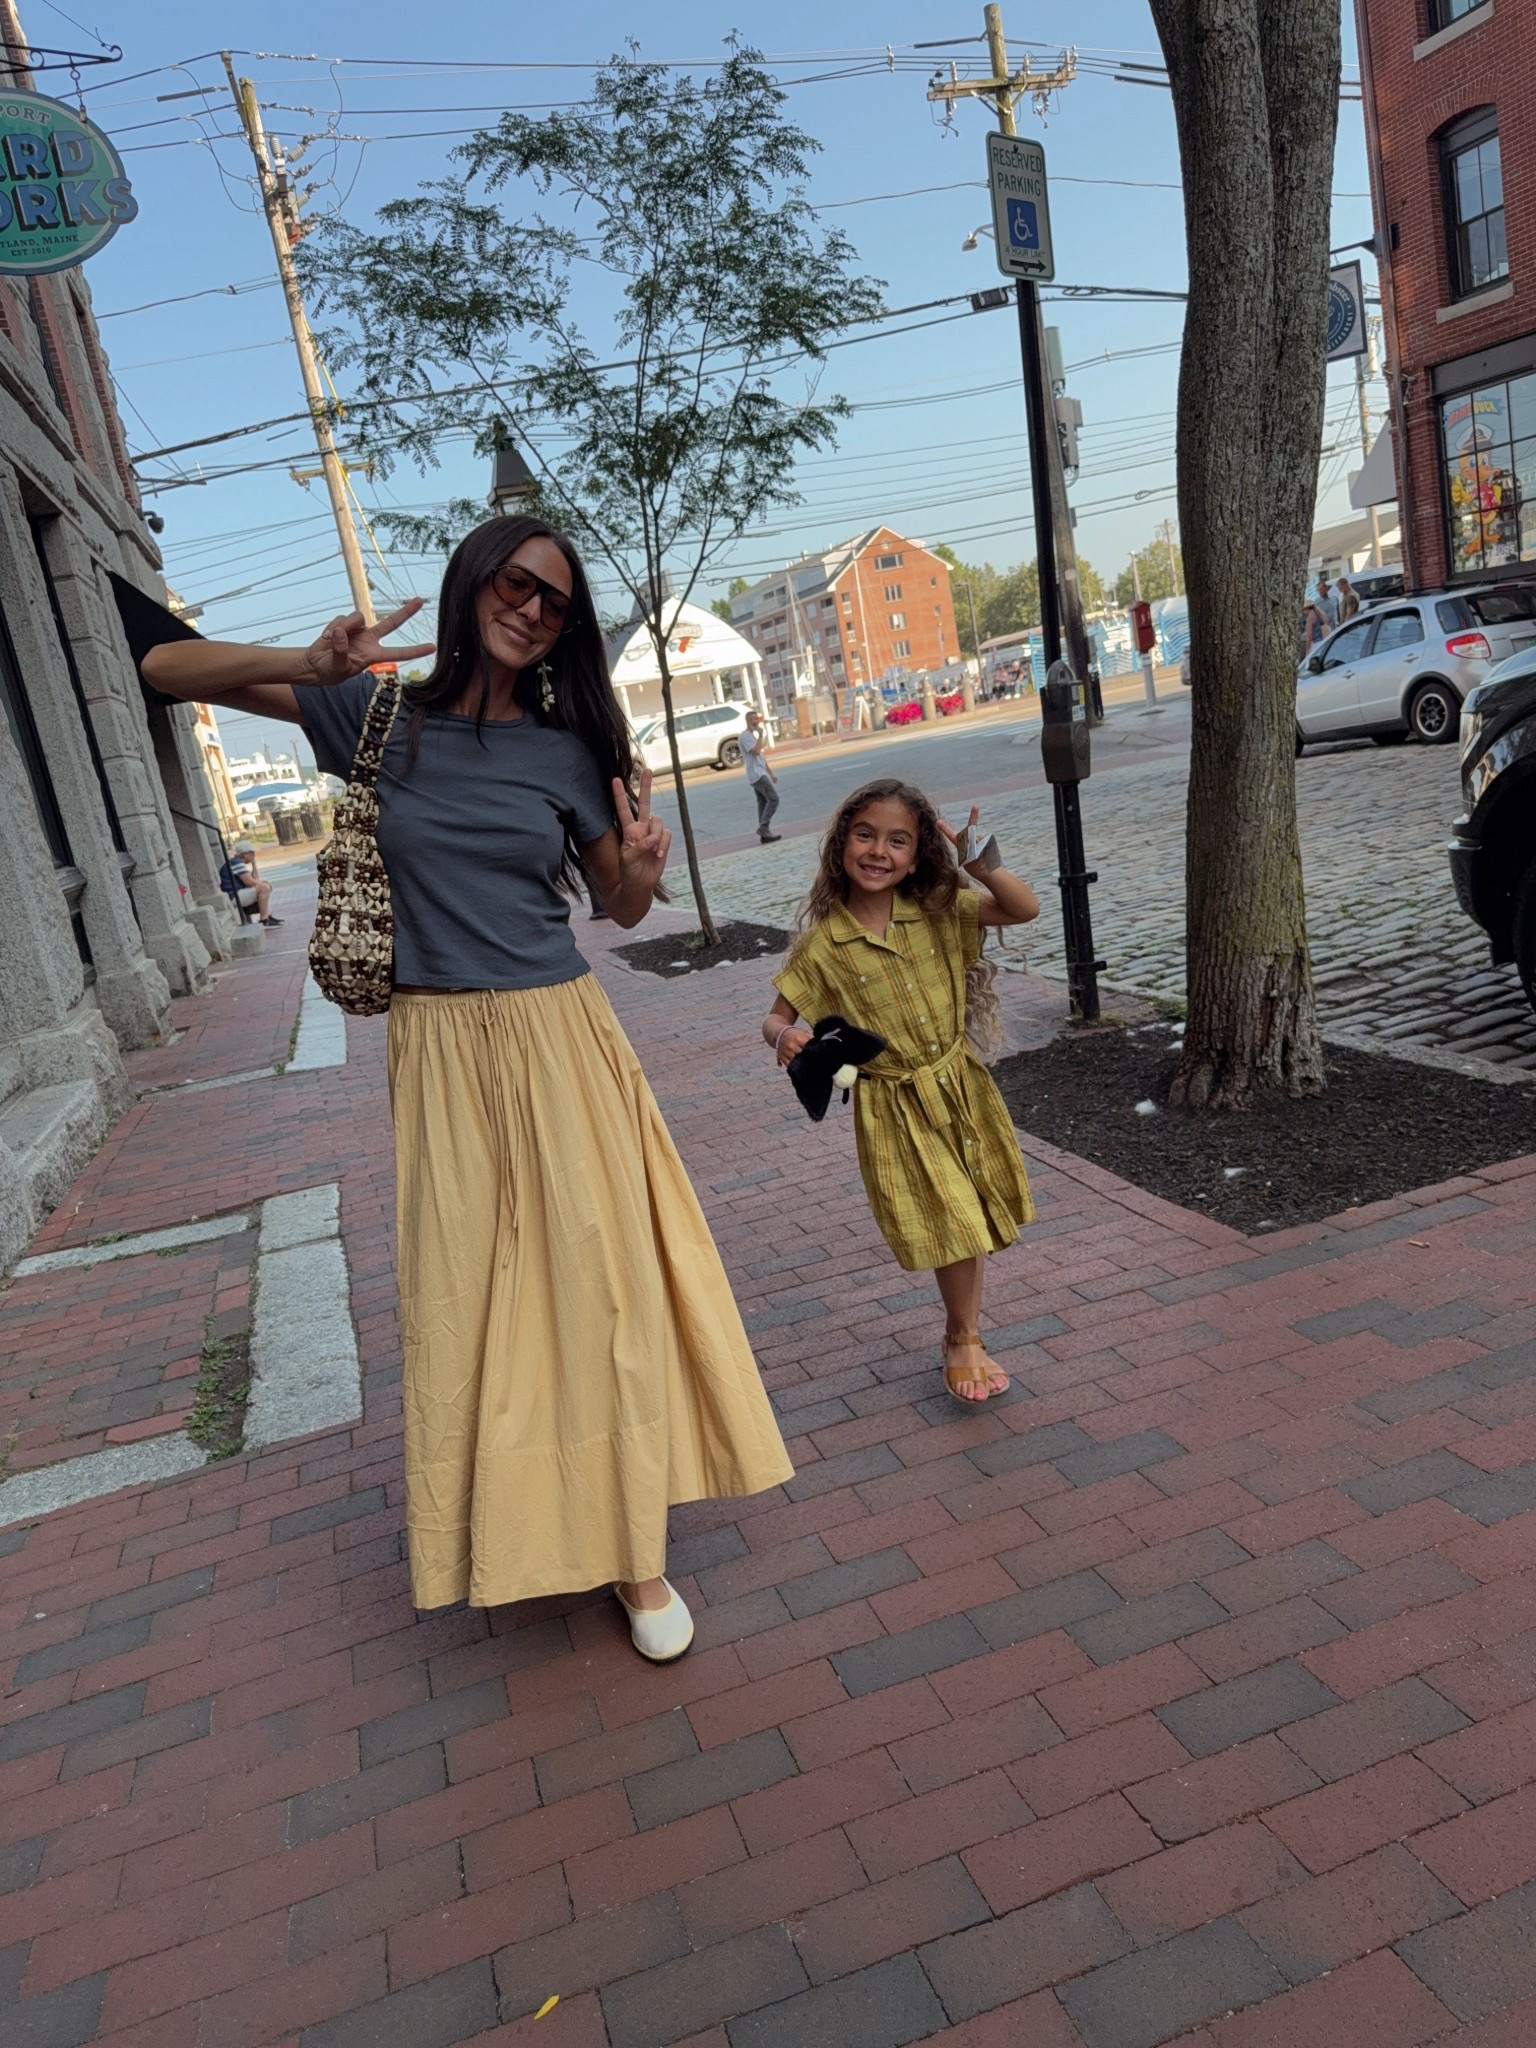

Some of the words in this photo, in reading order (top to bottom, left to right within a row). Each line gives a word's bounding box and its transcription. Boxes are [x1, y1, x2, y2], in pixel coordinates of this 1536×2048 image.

[0, 130, 94, 181] RD
[992, 146, 1042, 173] RESERVED
[997, 171, 1041, 197] PARKING
[41, 234, 79, 245] MAINE
[10, 249, 28, 257] EST
[1012, 247, 1029, 257] HOUR
[1473, 400, 1498, 414] DUCK
